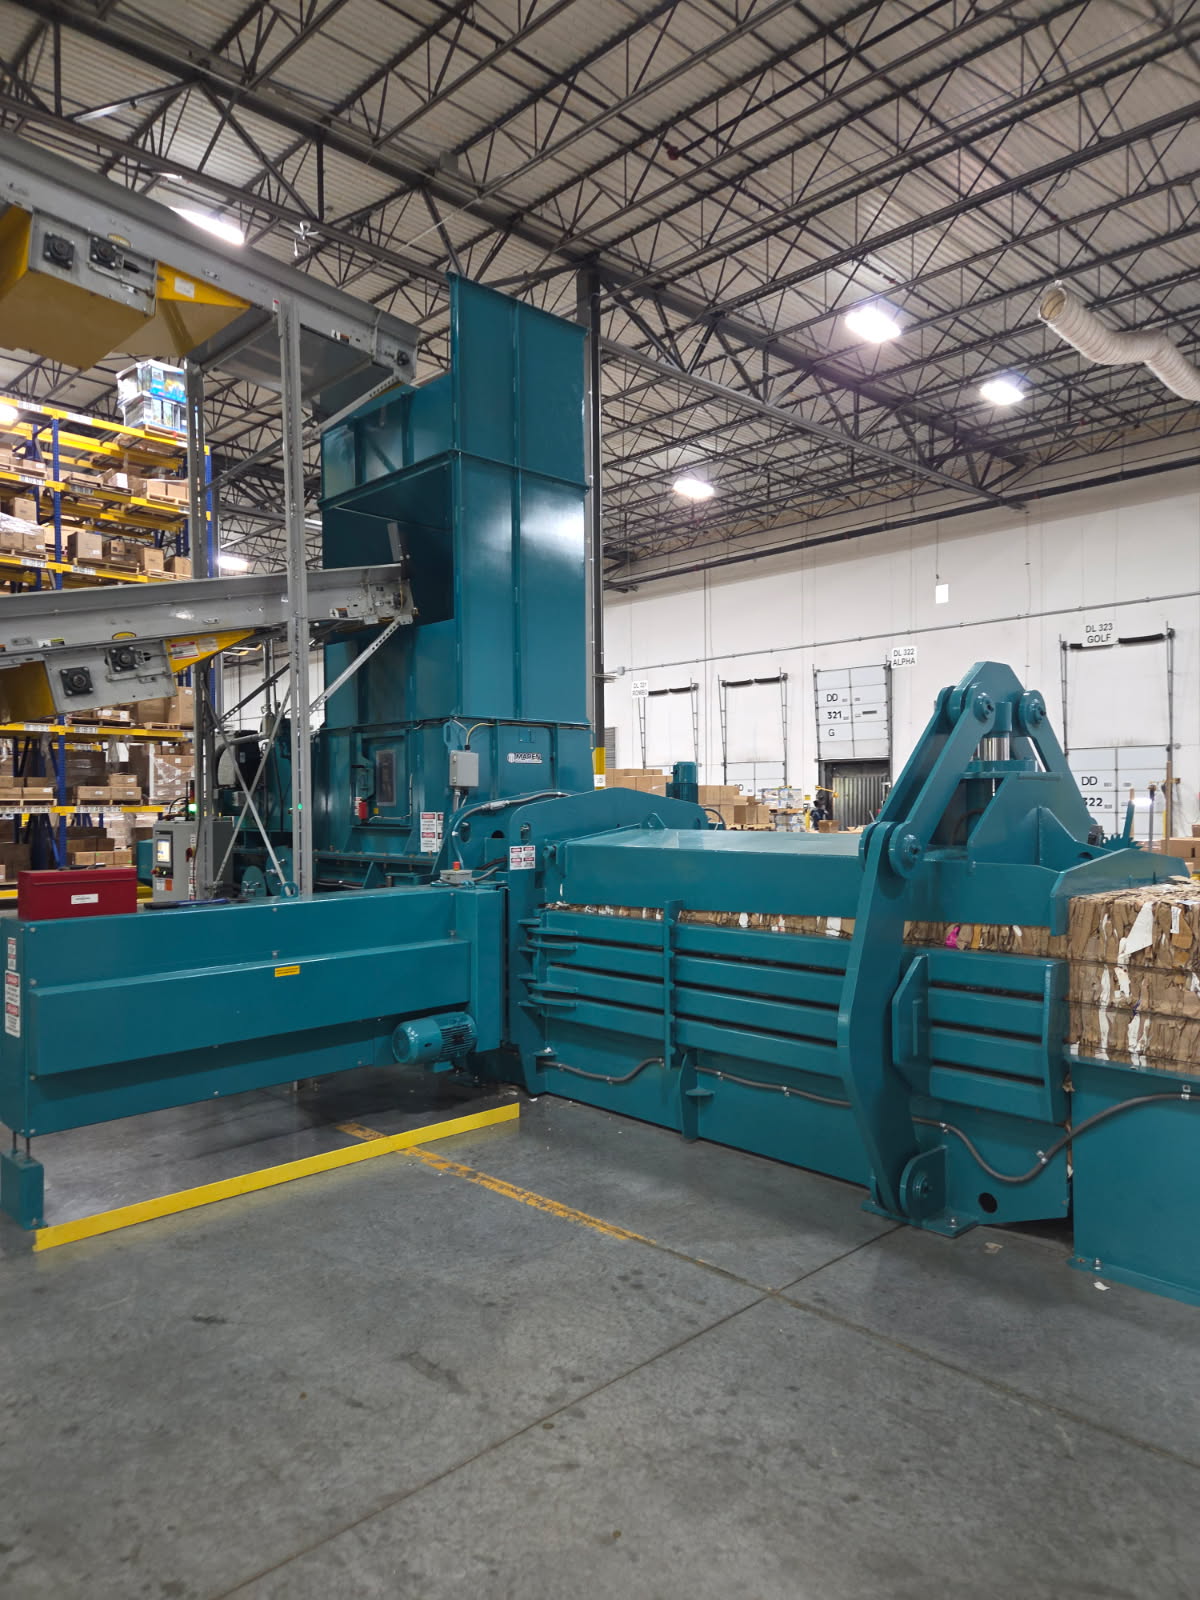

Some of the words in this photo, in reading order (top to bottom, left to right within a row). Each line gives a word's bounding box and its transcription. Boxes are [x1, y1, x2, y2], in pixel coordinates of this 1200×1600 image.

[1085, 624, 1097, 633] DL
[1098, 622, 1113, 632] 323
[1086, 633, 1112, 643] GOLF
[893, 649, 902, 657] DL
[892, 657, 916, 666] ALPHA
[826, 693, 839, 702] DD
[827, 710, 842, 720] 321
[828, 728, 836, 737] G
[1081, 776, 1098, 786] DD
